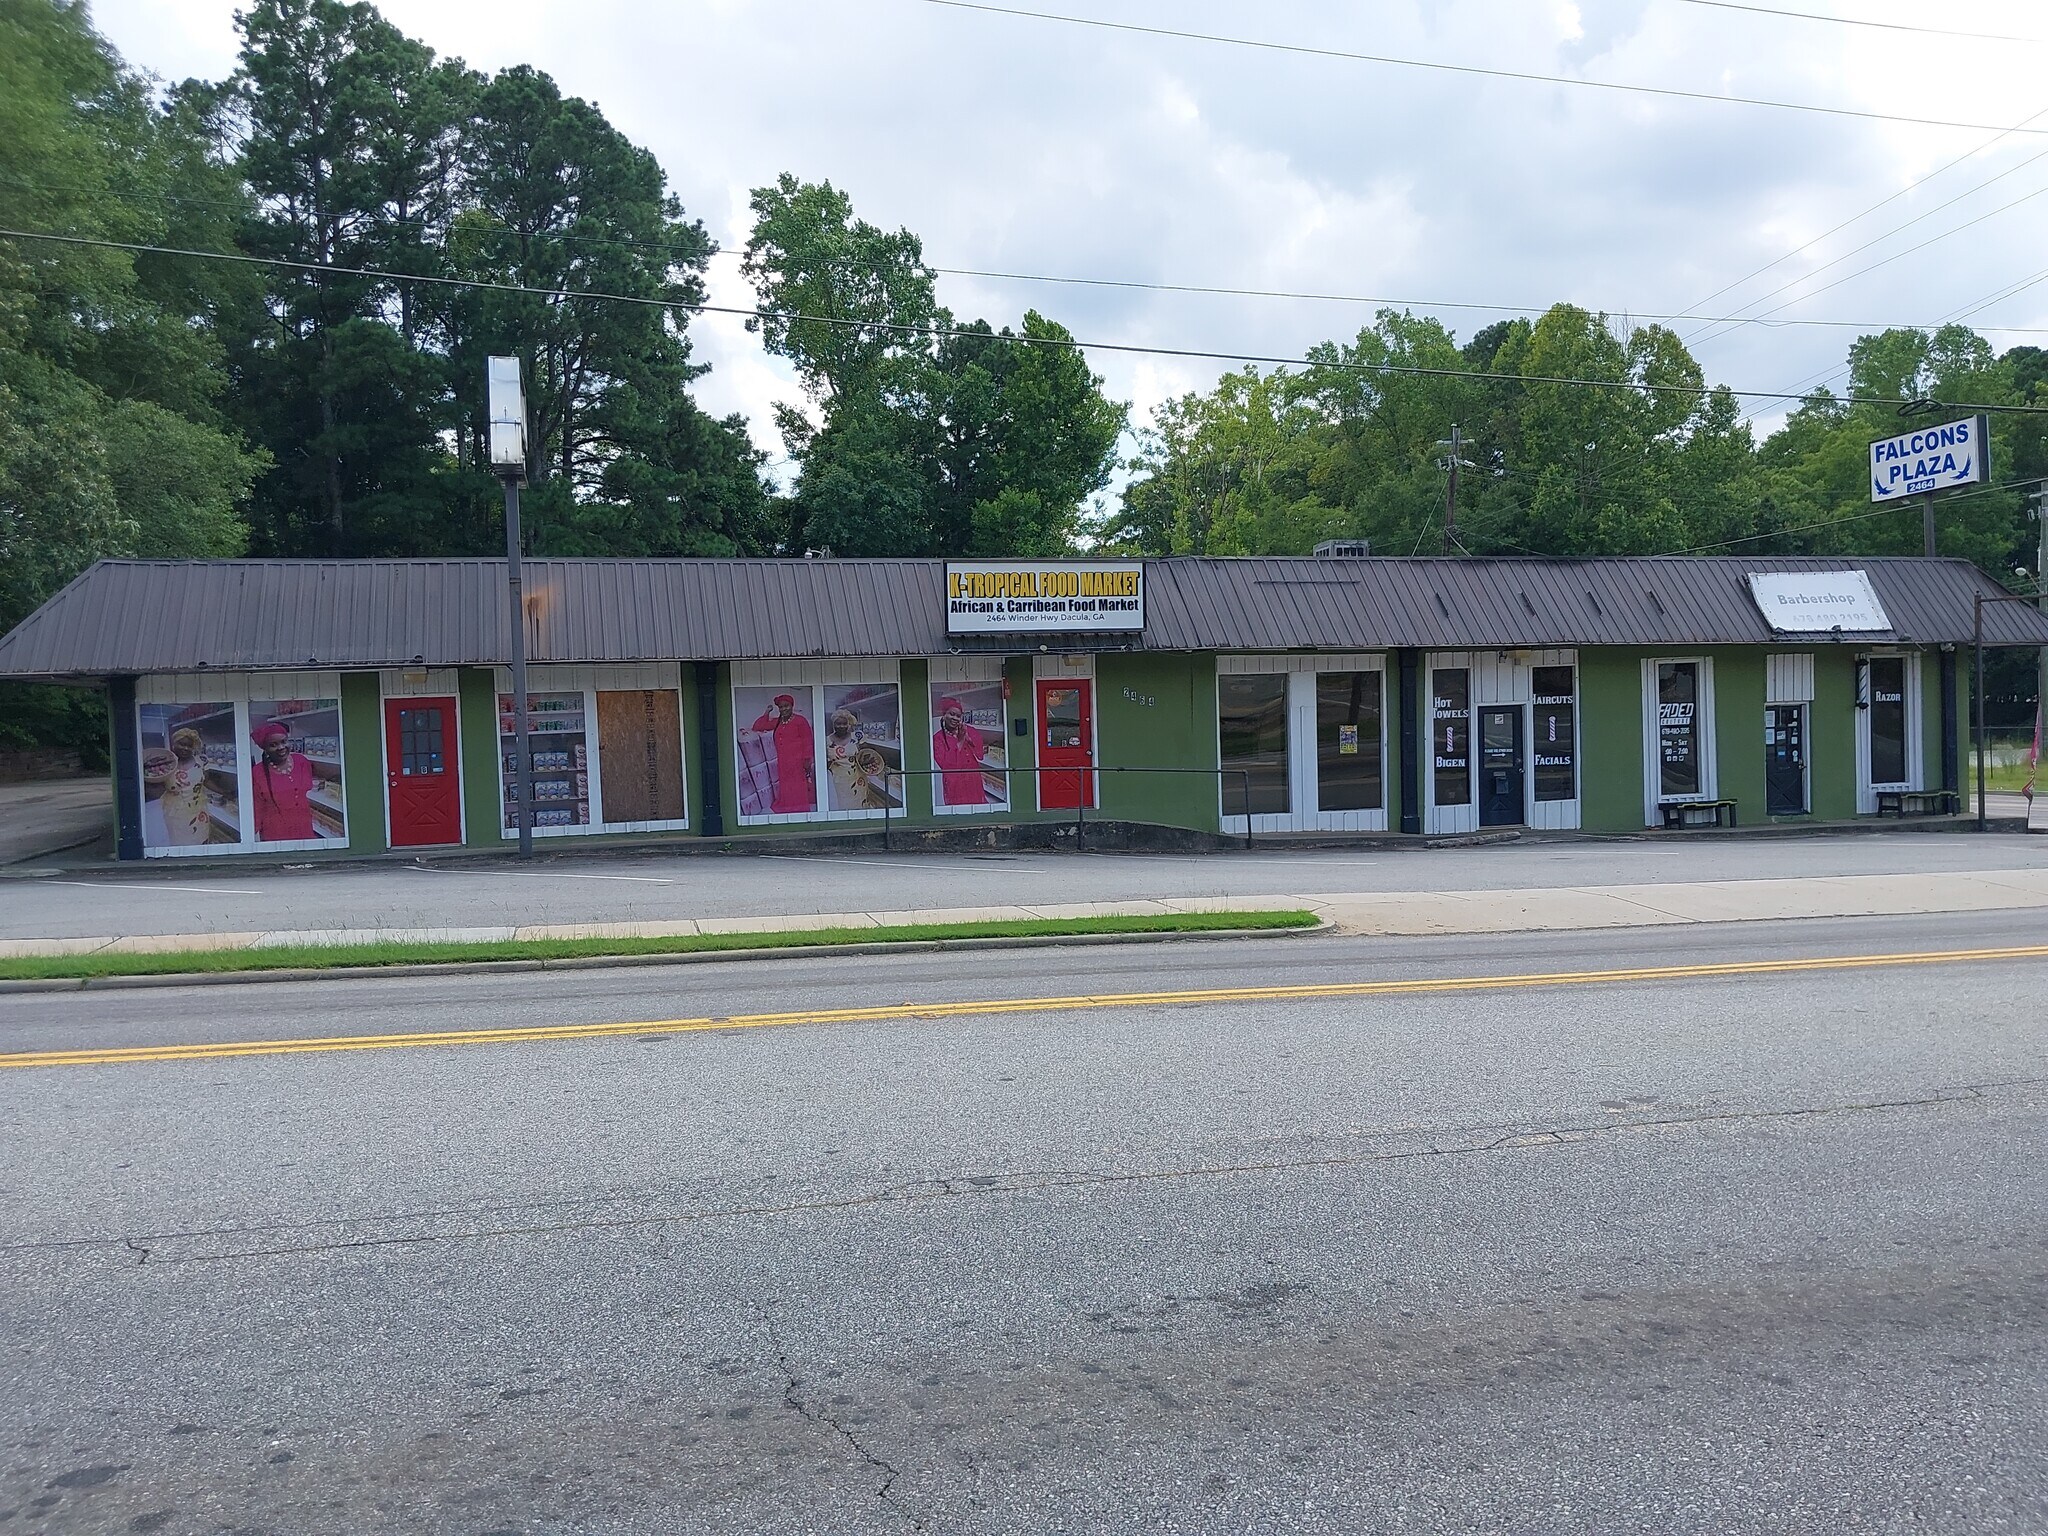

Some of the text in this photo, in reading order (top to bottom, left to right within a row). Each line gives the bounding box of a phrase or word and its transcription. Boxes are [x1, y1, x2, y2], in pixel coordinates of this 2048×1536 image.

[1875, 423, 1969, 463] FALCONS
[1889, 453, 1957, 484] PLAZA
[1909, 480, 1934, 492] 2464
[949, 571, 1140, 598] K-TROPICAL FOOD MARKET
[1777, 593, 1856, 605] Barbershop
[950, 598, 1139, 613] African & Carribean Food Market
[986, 613, 1105, 623] 2464 Winder Hwy Dacula, GA
[1434, 697, 1452, 708] HOT
[1875, 691, 1901, 702] RAZOR
[1660, 703, 1694, 717] FADED
[1436, 756, 1466, 767] BIGEN
[1535, 754, 1571, 765] FACIALS
